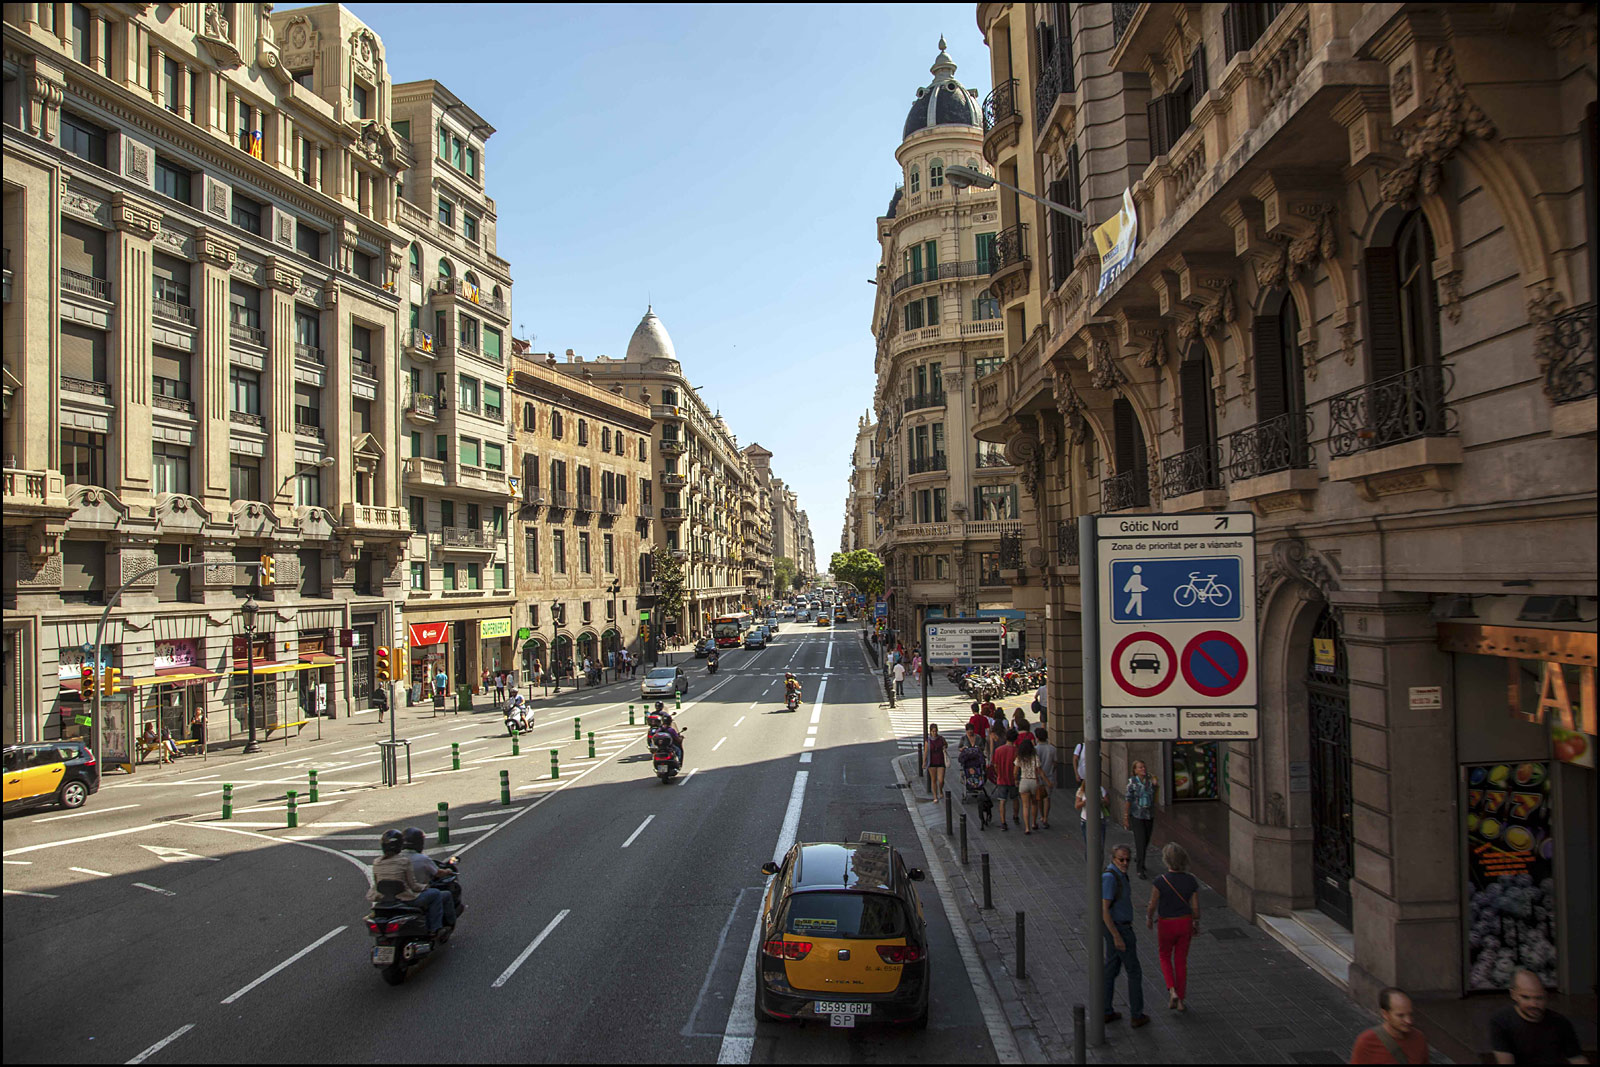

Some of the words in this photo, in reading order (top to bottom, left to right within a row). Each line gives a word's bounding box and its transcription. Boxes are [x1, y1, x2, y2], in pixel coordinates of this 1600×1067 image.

[1152, 520, 1179, 531] Nord
[1112, 542, 1133, 551] Zona
[1135, 542, 1146, 550] de
[1149, 541, 1181, 551] prioritat
[1184, 542, 1199, 551] per
[1207, 541, 1243, 549] vianants
[821, 1002, 847, 1013] 9599
[849, 1003, 869, 1014] GRM
[833, 1015, 852, 1026] SP
